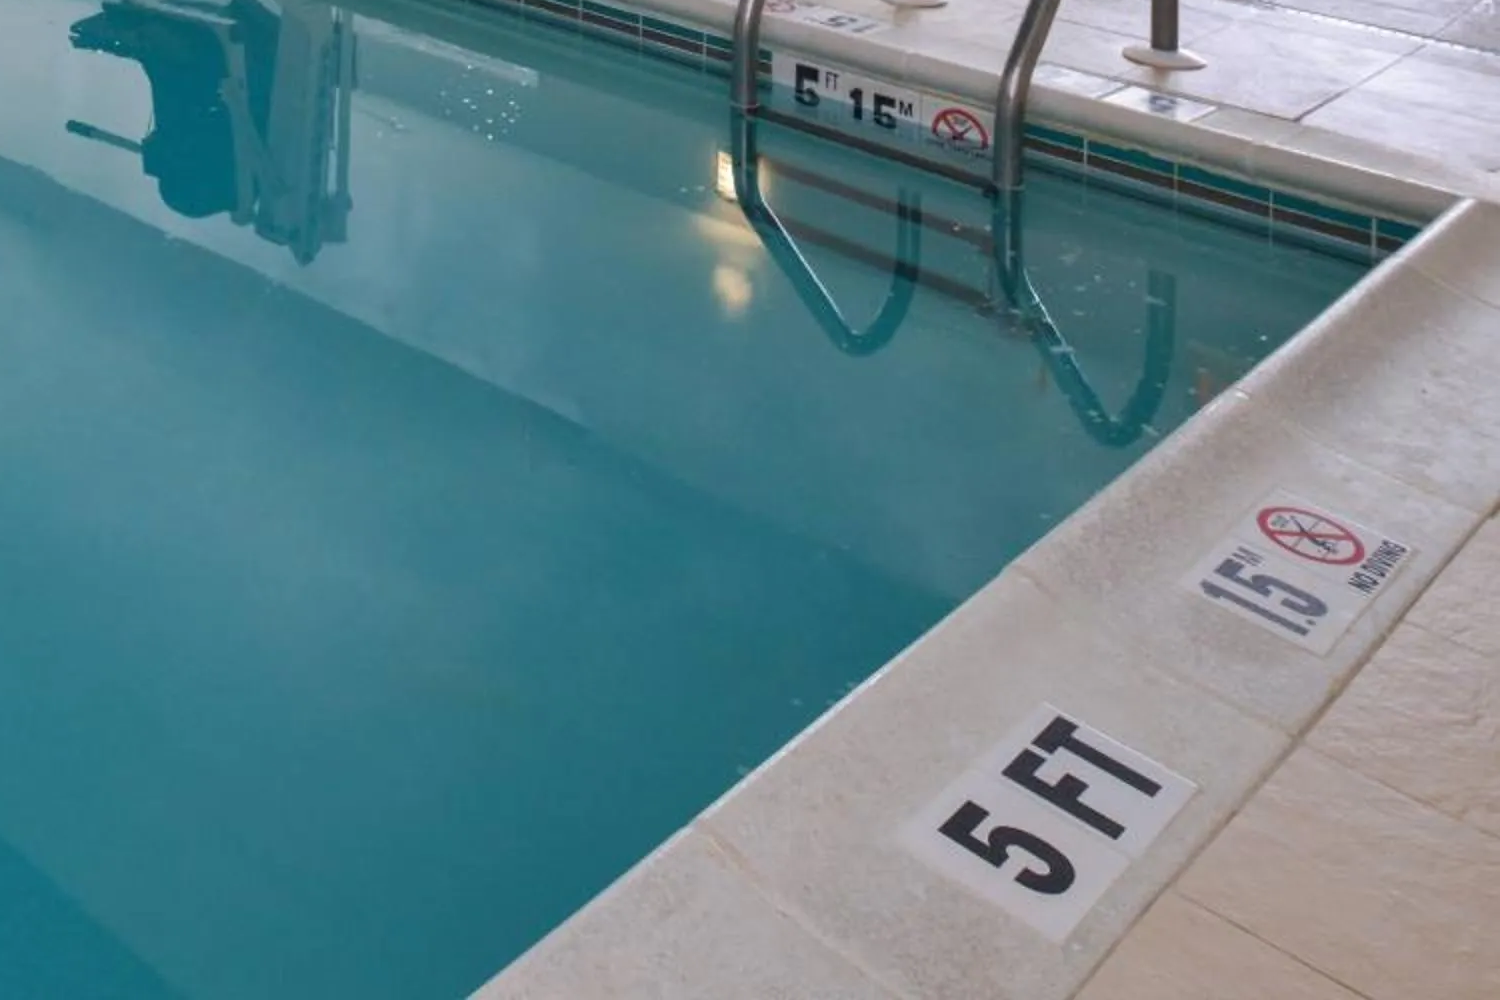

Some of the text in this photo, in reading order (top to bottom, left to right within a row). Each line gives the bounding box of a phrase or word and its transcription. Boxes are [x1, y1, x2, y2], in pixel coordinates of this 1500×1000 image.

[1348, 539, 1408, 600] NO DIVING
[938, 716, 1162, 895] 5 FT
